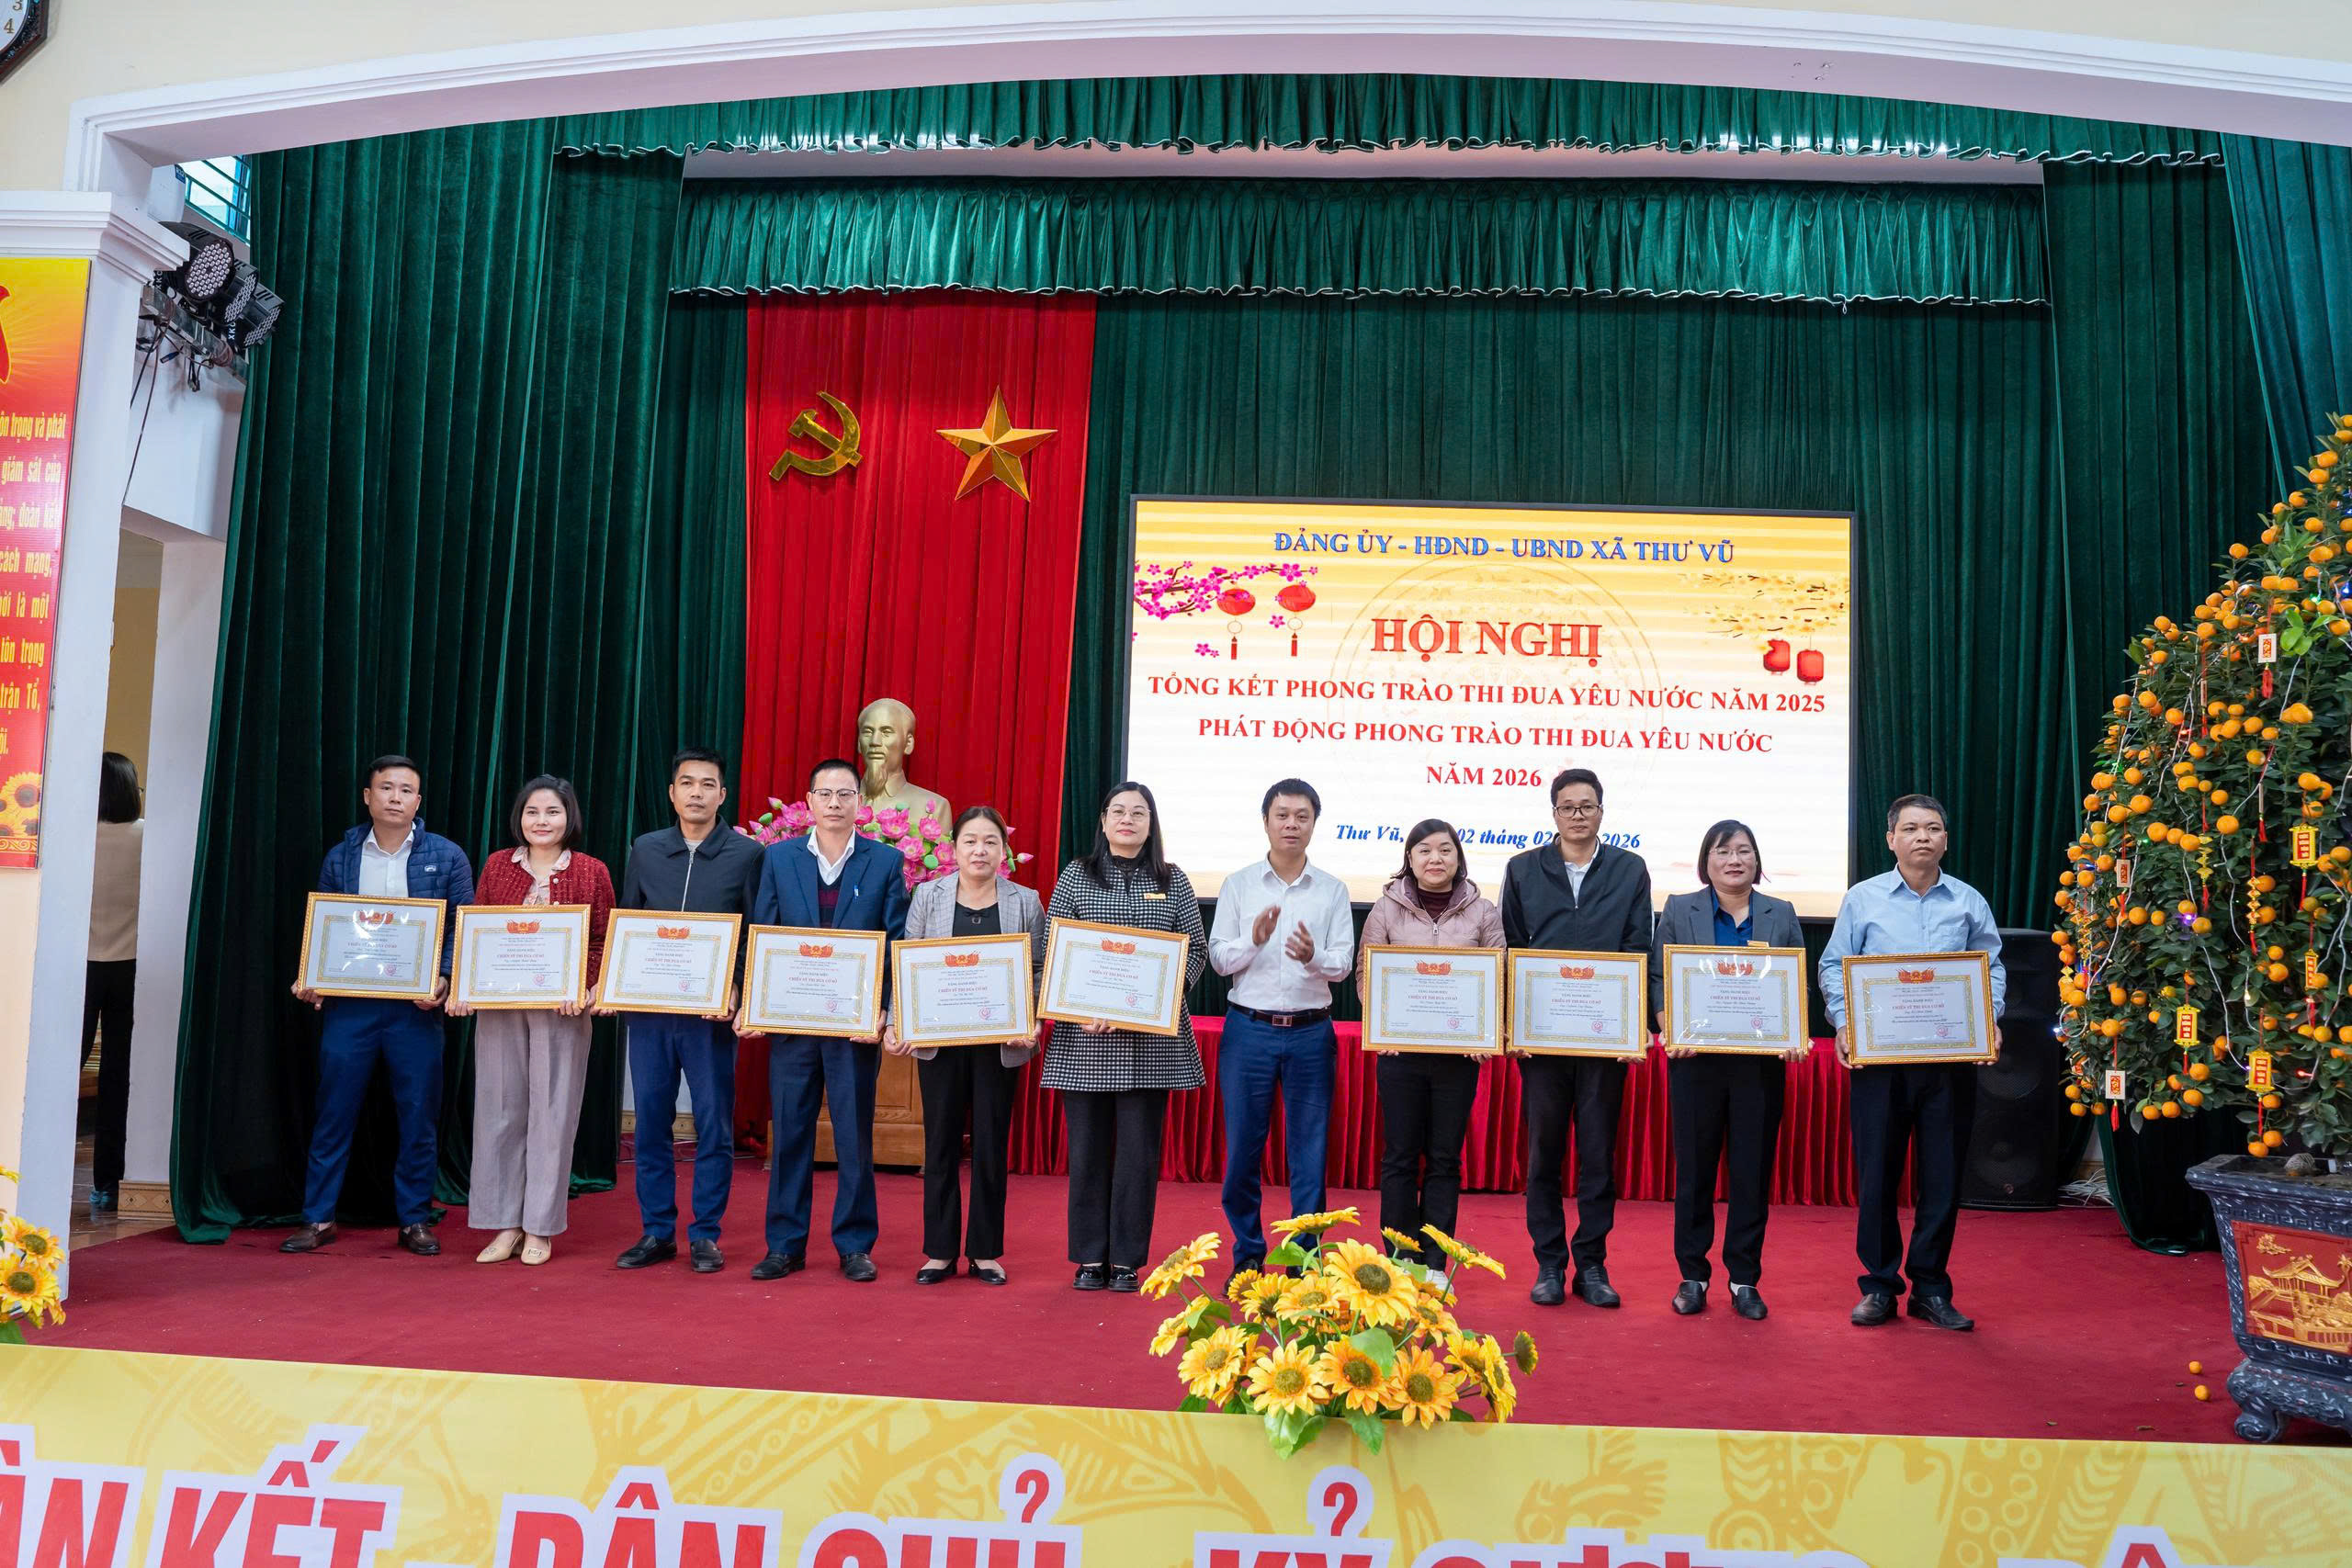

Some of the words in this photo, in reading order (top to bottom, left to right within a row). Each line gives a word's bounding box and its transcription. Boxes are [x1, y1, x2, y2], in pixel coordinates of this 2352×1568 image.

[4, 18, 15, 34] 4
[10, 412, 33, 443] trọng
[34, 412, 45, 438] và
[45, 412, 66, 441] phát
[2, 456, 24, 485] giám
[1273, 527, 1349, 553] ĐẢNG
[1356, 529, 1393, 553] ỦY
[1414, 536, 1489, 556] HĐND
[1511, 537, 1584, 558] UBND
[1590, 536, 1627, 559] XÃ
[1634, 539, 1693, 562] THƯ
[1698, 539, 1735, 563] VŨ
[25, 552, 52, 580] mạng,
[16, 591, 26, 618] là
[30, 592, 50, 624] một
[0, 636, 16, 662] tôn
[20, 637, 45, 669] trọng
[1370, 614, 1464, 662] HỘI
[1475, 620, 1602, 668] NGHỊ
[0, 682, 20, 715] trận
[1148, 671, 1220, 695] TỔNG
[1227, 673, 1279, 696] KẾT
[1285, 679, 1375, 700] PHONG
[1382, 678, 1453, 702] TRÀO
[1459, 684, 1504, 704] THI
[1511, 685, 1565, 705] ĐUA
[1569, 682, 1621, 706] YÊU
[1628, 684, 1702, 709] NƯỚC
[1711, 687, 1769, 711] NĂM
[1775, 693, 1826, 713] 2025
[1198, 714, 1266, 738] PHÁT
[1272, 717, 1347, 743] ĐỘNG
[1354, 722, 1444, 743] PHONG
[1451, 721, 1522, 745] TRÀO
[1529, 727, 1574, 747] THI
[1580, 728, 1634, 748] ĐUA
[1638, 726, 1690, 750] YÊU
[1698, 728, 1773, 752] NƯỚC
[1426, 762, 1485, 785] NĂM
[1491, 768, 1543, 787] 2026
[1336, 824, 1372, 840] Thư
[1376, 825, 1405, 843] Vũ,
[1457, 828, 1474, 844] 02
[1479, 829, 1529, 850] tháng
[1532, 830, 1554, 846] 02
[1601, 832, 1642, 849] 2026
